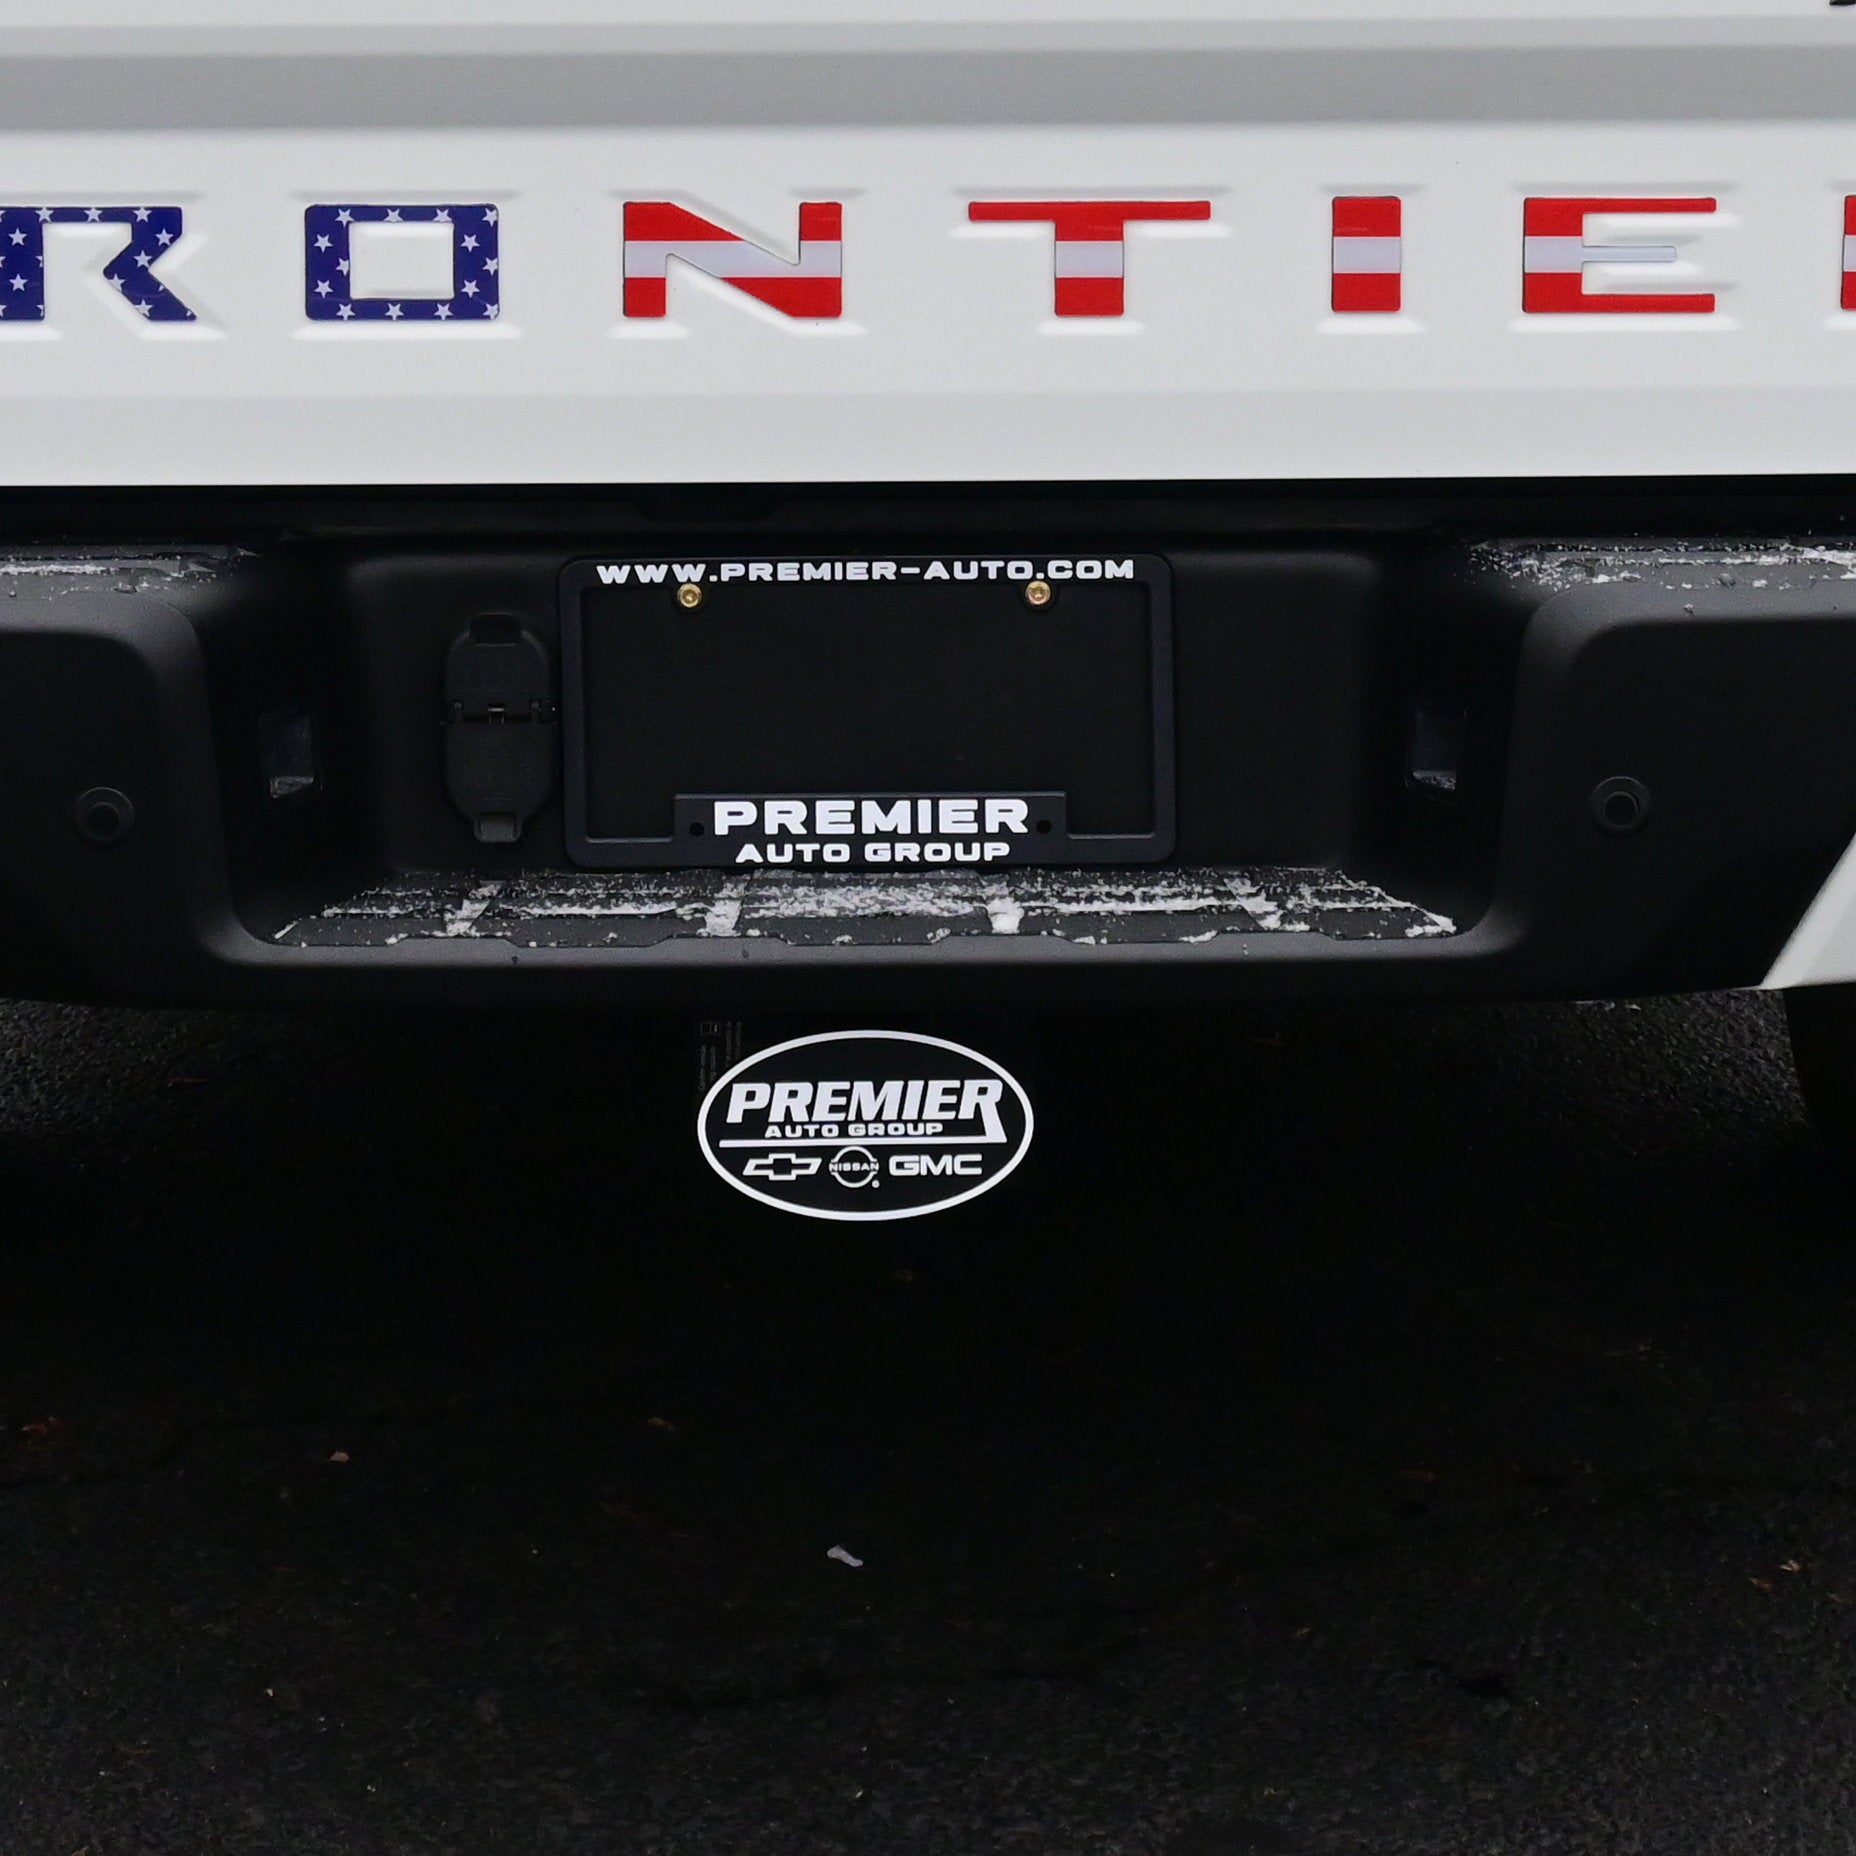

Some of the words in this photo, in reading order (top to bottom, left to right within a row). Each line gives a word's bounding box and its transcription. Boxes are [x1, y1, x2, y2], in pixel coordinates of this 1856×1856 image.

[597, 559, 1134, 585] WWW.PREMIER-AUTO.COM
[713, 798, 1029, 836] PREMIER
[734, 842, 851, 863] AUTO
[863, 841, 1011, 863] GROUP
[725, 1079, 1005, 1124] PREMIER
[764, 1123, 840, 1139] AUTO
[847, 1121, 944, 1137] GROUP
[828, 1161, 880, 1173] NISSAN
[888, 1153, 983, 1177] GMC
